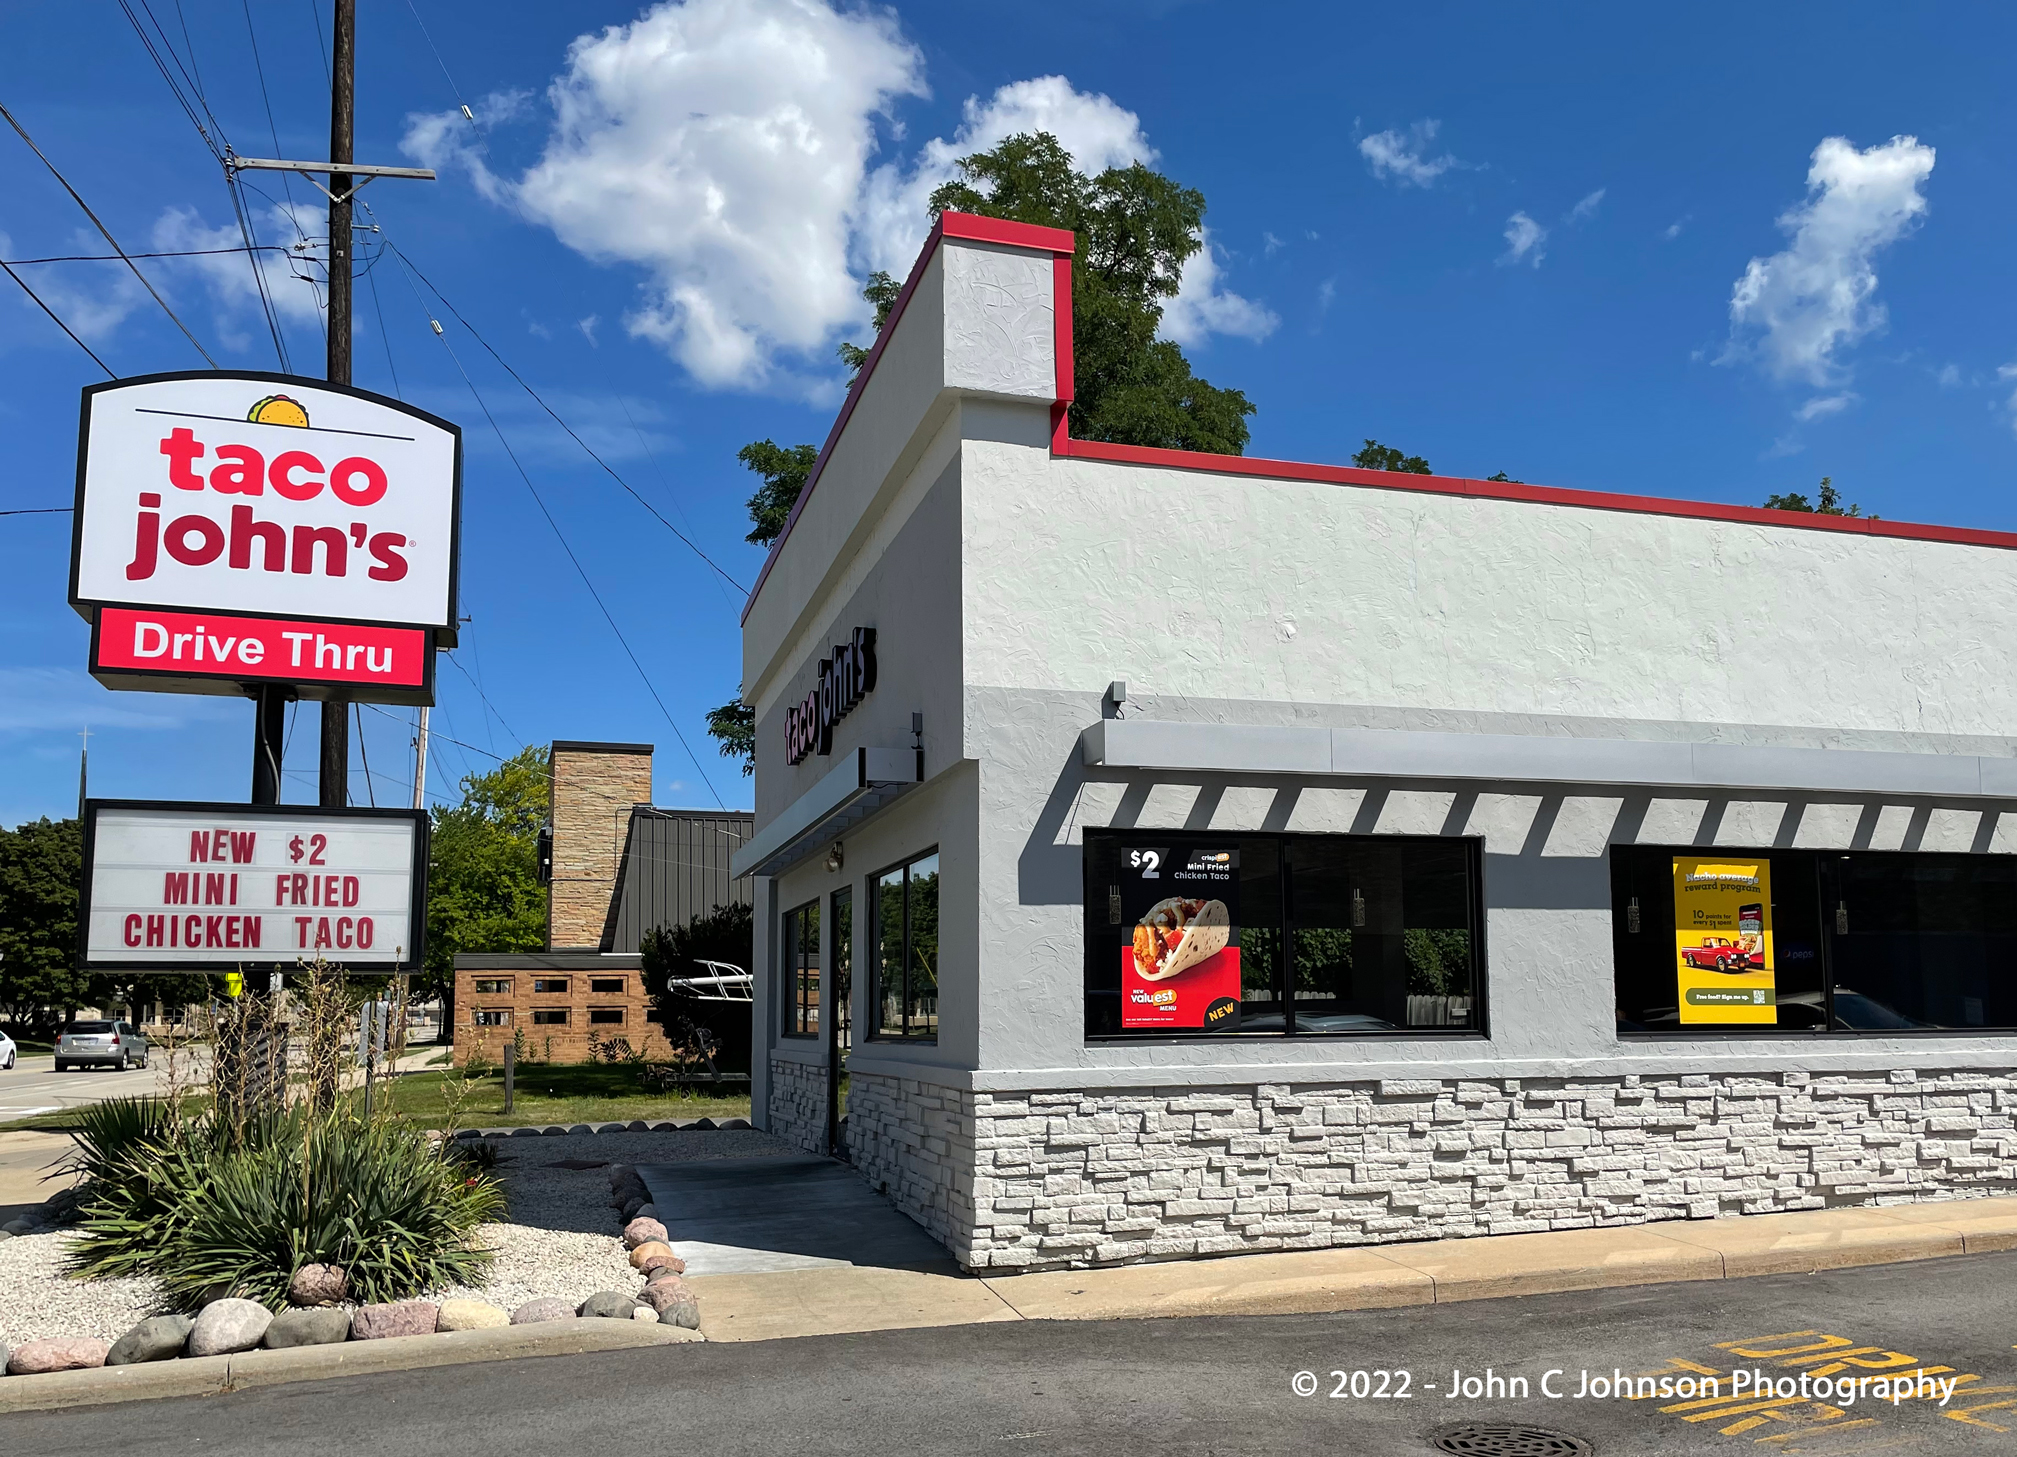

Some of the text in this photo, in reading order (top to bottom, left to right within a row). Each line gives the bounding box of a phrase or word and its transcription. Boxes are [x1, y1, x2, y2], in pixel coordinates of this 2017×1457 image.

[159, 427, 388, 507] taco
[125, 492, 409, 582] john's
[133, 621, 393, 672] Drive Thru
[785, 690, 818, 766] taco
[190, 829, 327, 866] NEW $2
[1130, 849, 1160, 879] $2
[1174, 871, 1230, 880] Chicken Taco
[1187, 862, 1230, 871] Mini Fried
[1685, 872, 1759, 885] Nacho average
[163, 872, 359, 907] MINI FRIED
[1684, 882, 1761, 894] reward program
[1693, 910, 1704, 919] 10
[124, 913, 374, 950] CHICKEN TACO
[1208, 1002, 1234, 1022] NEW
